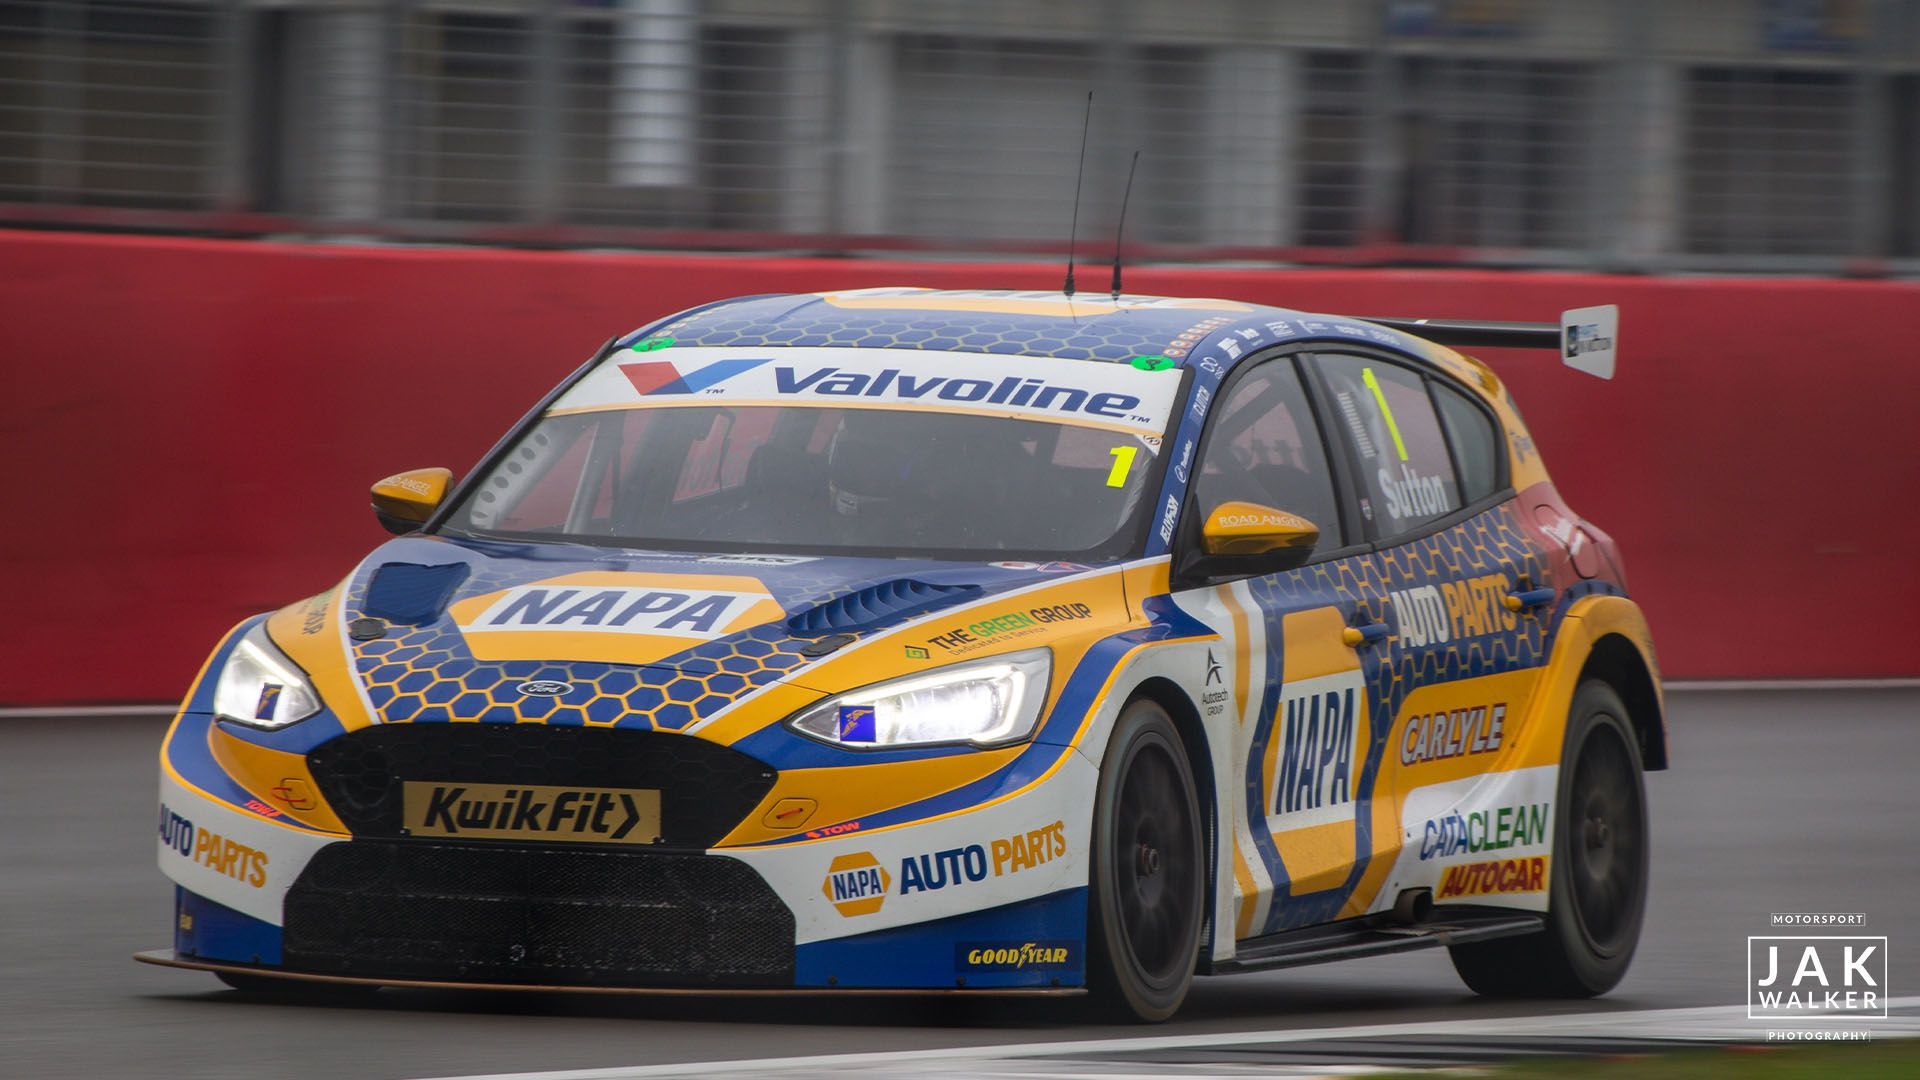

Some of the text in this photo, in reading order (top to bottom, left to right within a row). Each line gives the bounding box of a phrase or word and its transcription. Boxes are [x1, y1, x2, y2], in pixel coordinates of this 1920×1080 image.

[775, 367, 1141, 418] Valvoline
[1362, 367, 1408, 461] 1
[1106, 445, 1138, 488] 1
[1378, 463, 1450, 519] Sutton
[1219, 514, 1258, 527] ROAD
[492, 590, 737, 632] NAPA
[928, 603, 1092, 650] THE GREEN GROUP
[1391, 573, 1517, 649] AUTO PARTS
[1202, 688, 1229, 704] Autotech
[1207, 705, 1224, 716] GROUP
[1276, 687, 1354, 815] NAPA
[1401, 702, 1507, 766] CARLYLE
[821, 822, 860, 836] TOW
[194, 826, 269, 888] PARTS
[900, 820, 1066, 895] AUTO PARTS
[1440, 857, 1544, 898] AUTOCAR
[833, 868, 883, 900] NAPA
[968, 943, 1068, 968] GOODYEAR
